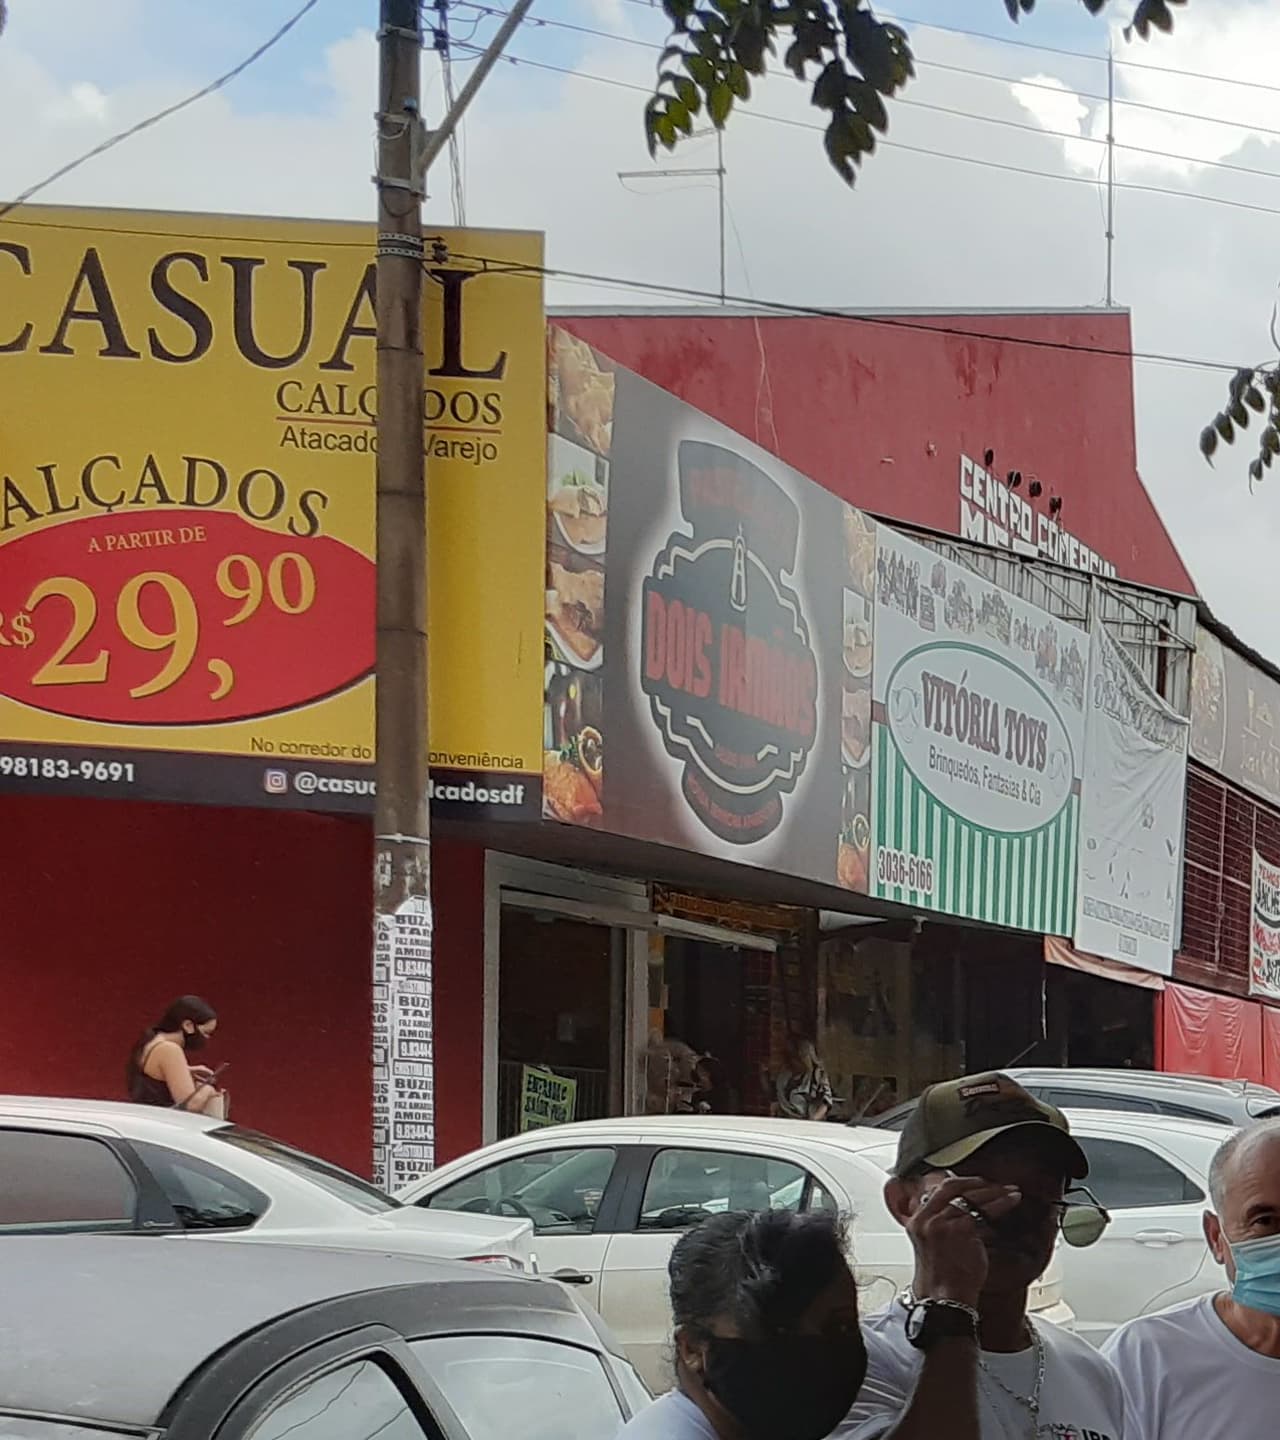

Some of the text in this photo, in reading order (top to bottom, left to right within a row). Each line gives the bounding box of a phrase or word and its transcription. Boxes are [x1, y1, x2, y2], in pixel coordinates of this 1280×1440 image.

[275, 380, 502, 425] CALÇDOS
[960, 454, 1032, 543] CENTRO
[88, 526, 207, 553] A PARTIR DE
[647, 590, 712, 699] DOIS
[921, 669, 1000, 756] VITÓRIA
[1004, 707, 1048, 773] TOYS
[250, 737, 524, 769] No corredor do onveniência
[929, 744, 981, 790] Brinquedos,
[1029, 783, 1041, 806] Cia
[877, 849, 933, 892] 3036-6166
